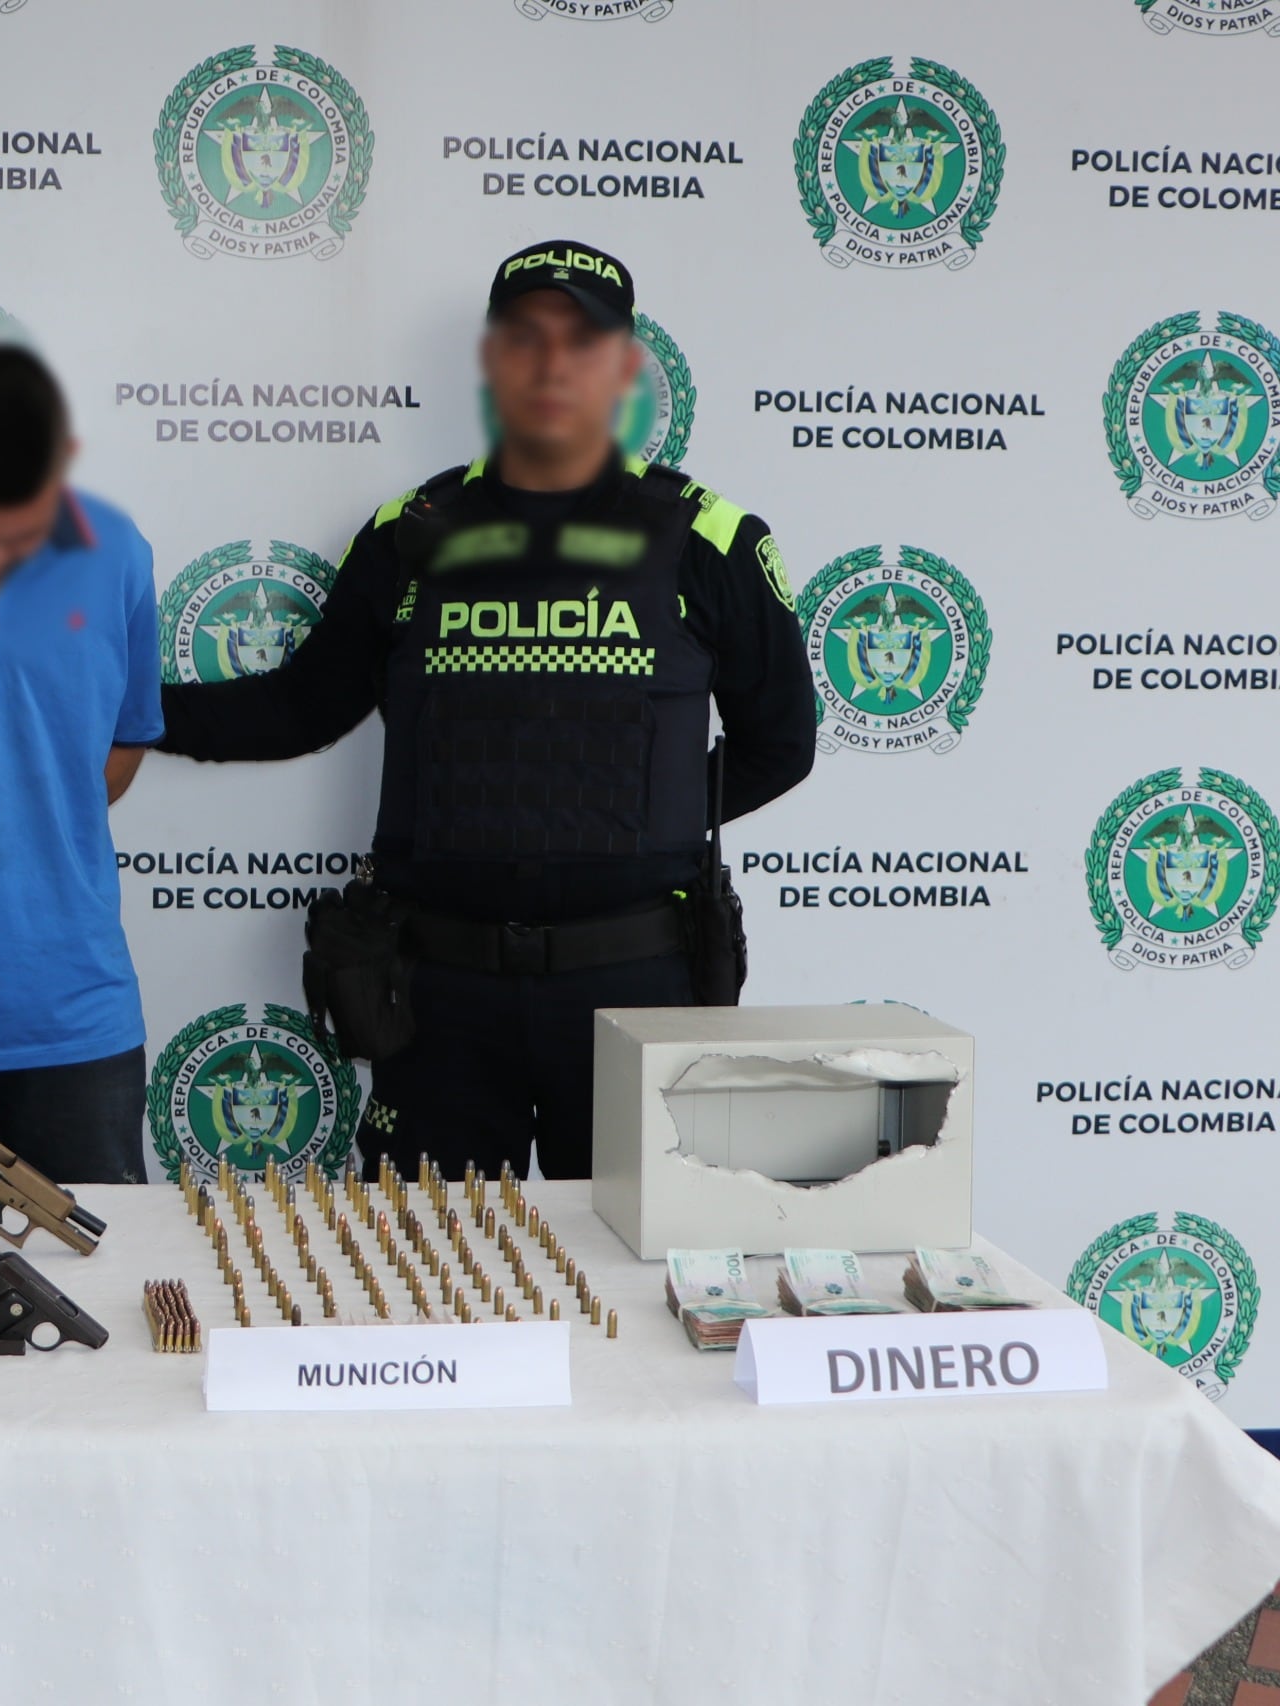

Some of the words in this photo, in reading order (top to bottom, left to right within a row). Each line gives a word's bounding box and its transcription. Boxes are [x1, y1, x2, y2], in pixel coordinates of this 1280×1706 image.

[1219, 8, 1273, 31] PATRIA
[255, 69, 279, 82] DE
[296, 79, 347, 165] COLOMBIA
[892, 81, 915, 93] DE
[931, 91, 979, 177] COLOMBIA
[443, 131, 570, 161] POLICÍA
[578, 138, 744, 164] NACIONAL
[1071, 144, 1193, 174] POLICÍA
[1201, 151, 1280, 176] NACI
[483, 173, 525, 196] DE
[533, 173, 705, 199] COLOMBIA
[1109, 185, 1150, 208] DE
[265, 184, 339, 234] NACIONAL
[900, 195, 972, 244] NACIONAL
[899, 241, 953, 265] PATRIA
[1199, 335, 1221, 347] DE
[116, 377, 244, 407] POLICÍA
[252, 384, 421, 409] NACIONAL
[754, 384, 877, 414] POLICÍA
[885, 391, 1046, 416] NACIONAL
[156, 419, 199, 442] DE
[207, 419, 382, 444] COLOMBIA
[792, 425, 834, 449] DE
[841, 426, 1008, 451] COLOMBIA
[1204, 446, 1274, 495] NACIONAL
[1203, 492, 1255, 515] PATRIA
[251, 564, 275, 577] DE
[439, 587, 641, 639] POLICÍA
[881, 569, 904, 581] DE
[919, 578, 966, 662] COLOMBIA
[1056, 628, 1175, 656] POLICÍA
[1183, 634, 1280, 656] NACIO
[1092, 668, 1133, 690] DE
[1140, 668, 1280, 690] COLOMBI
[887, 680, 958, 730] NACIONAL
[886, 726, 939, 750] PATRIA
[1180, 790, 1203, 802] DE
[1217, 799, 1261, 880] COLOMBIA
[742, 845, 863, 874] POLICÍA
[871, 851, 1029, 873] NACIONAL
[152, 887, 195, 910] DE
[779, 886, 820, 908] DE
[828, 885, 991, 908] COLOMBIA
[1183, 897, 1253, 946] NACIONAL
[1182, 942, 1234, 966] PATRIA
[246, 1027, 269, 1039] DE
[285, 1036, 334, 1118] COLOMBIA
[1036, 1074, 1153, 1103] POLICÍA
[1161, 1078, 1280, 1101] NACION
[1071, 1114, 1111, 1136] DE
[1118, 1111, 1276, 1135] COLOMBIA
[1156, 1234, 1178, 1246] DE
[1192, 1242, 1235, 1319] COLOMBIA
[297, 1354, 457, 1387] MUNICIÓN
[826, 1341, 1040, 1394] DINERO
